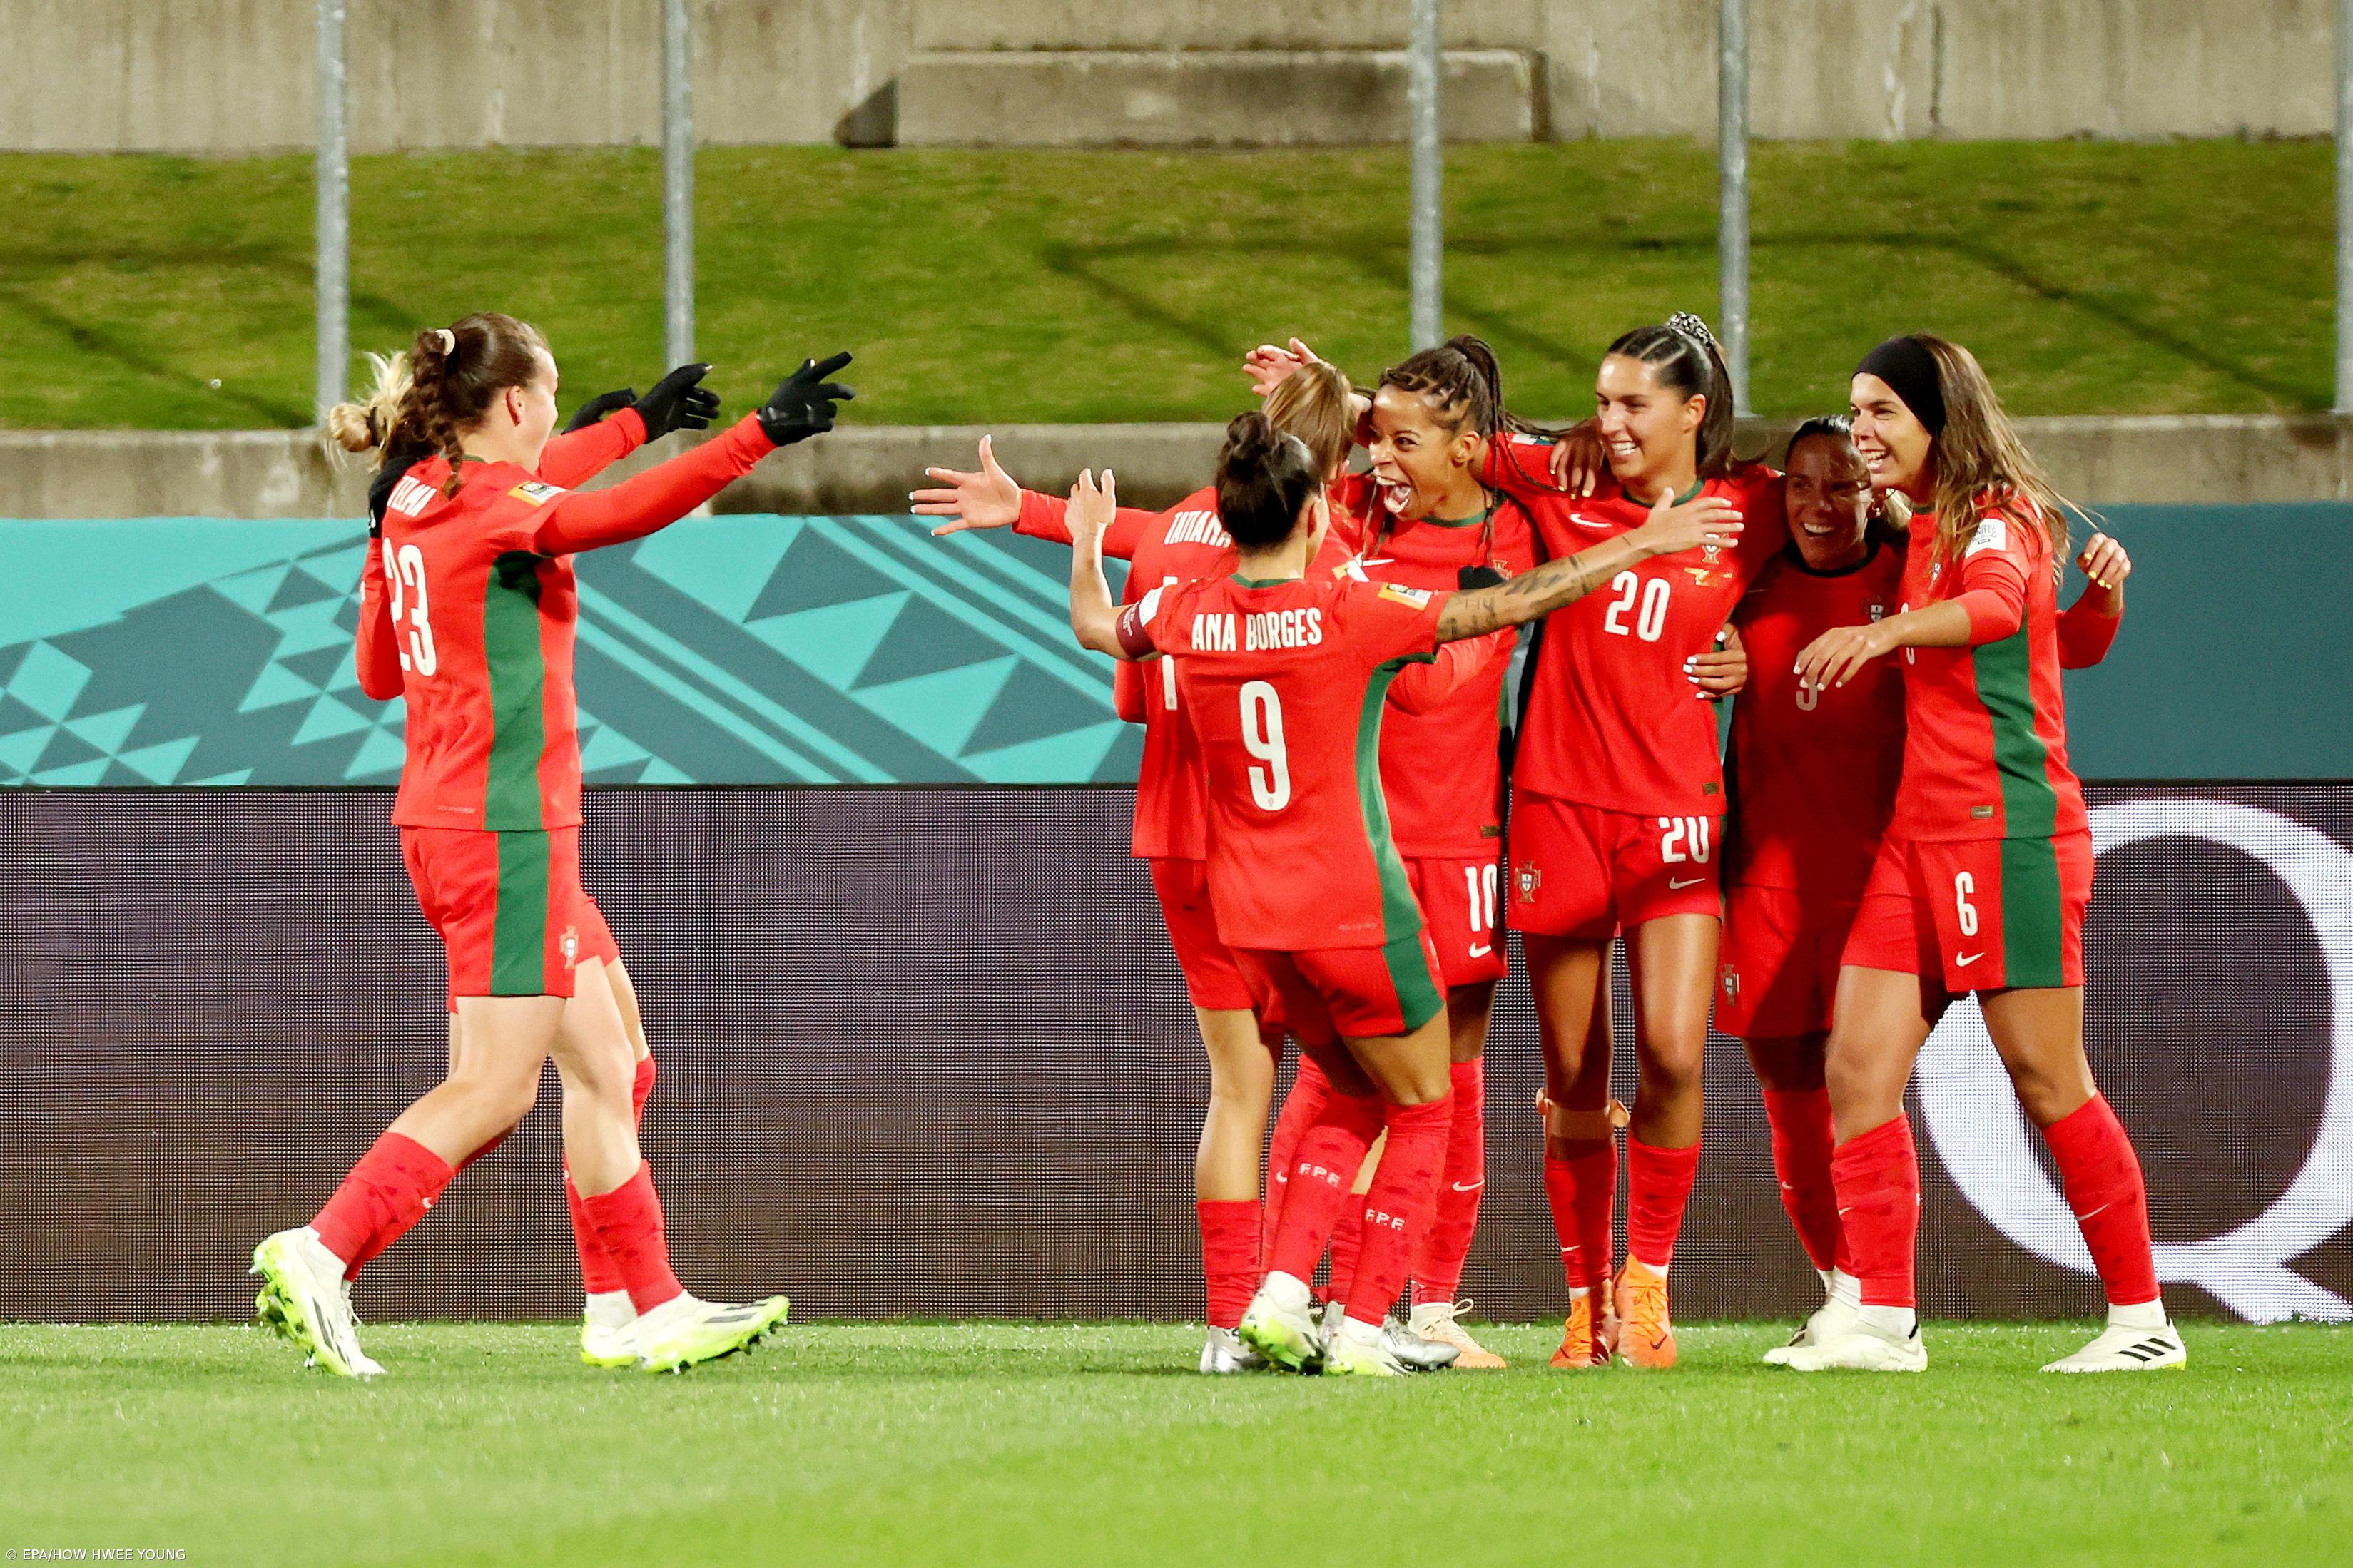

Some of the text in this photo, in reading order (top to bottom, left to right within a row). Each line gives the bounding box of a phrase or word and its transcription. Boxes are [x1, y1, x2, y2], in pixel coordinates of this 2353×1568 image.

[382, 536, 437, 677] 23
[1191, 613, 1237, 652] ANA
[1245, 607, 1323, 652] BORGES
[1604, 570, 1671, 642] 20
[1240, 680, 1291, 811] 9
[1658, 815, 1709, 865] 20
[1956, 870, 1979, 937] 6
